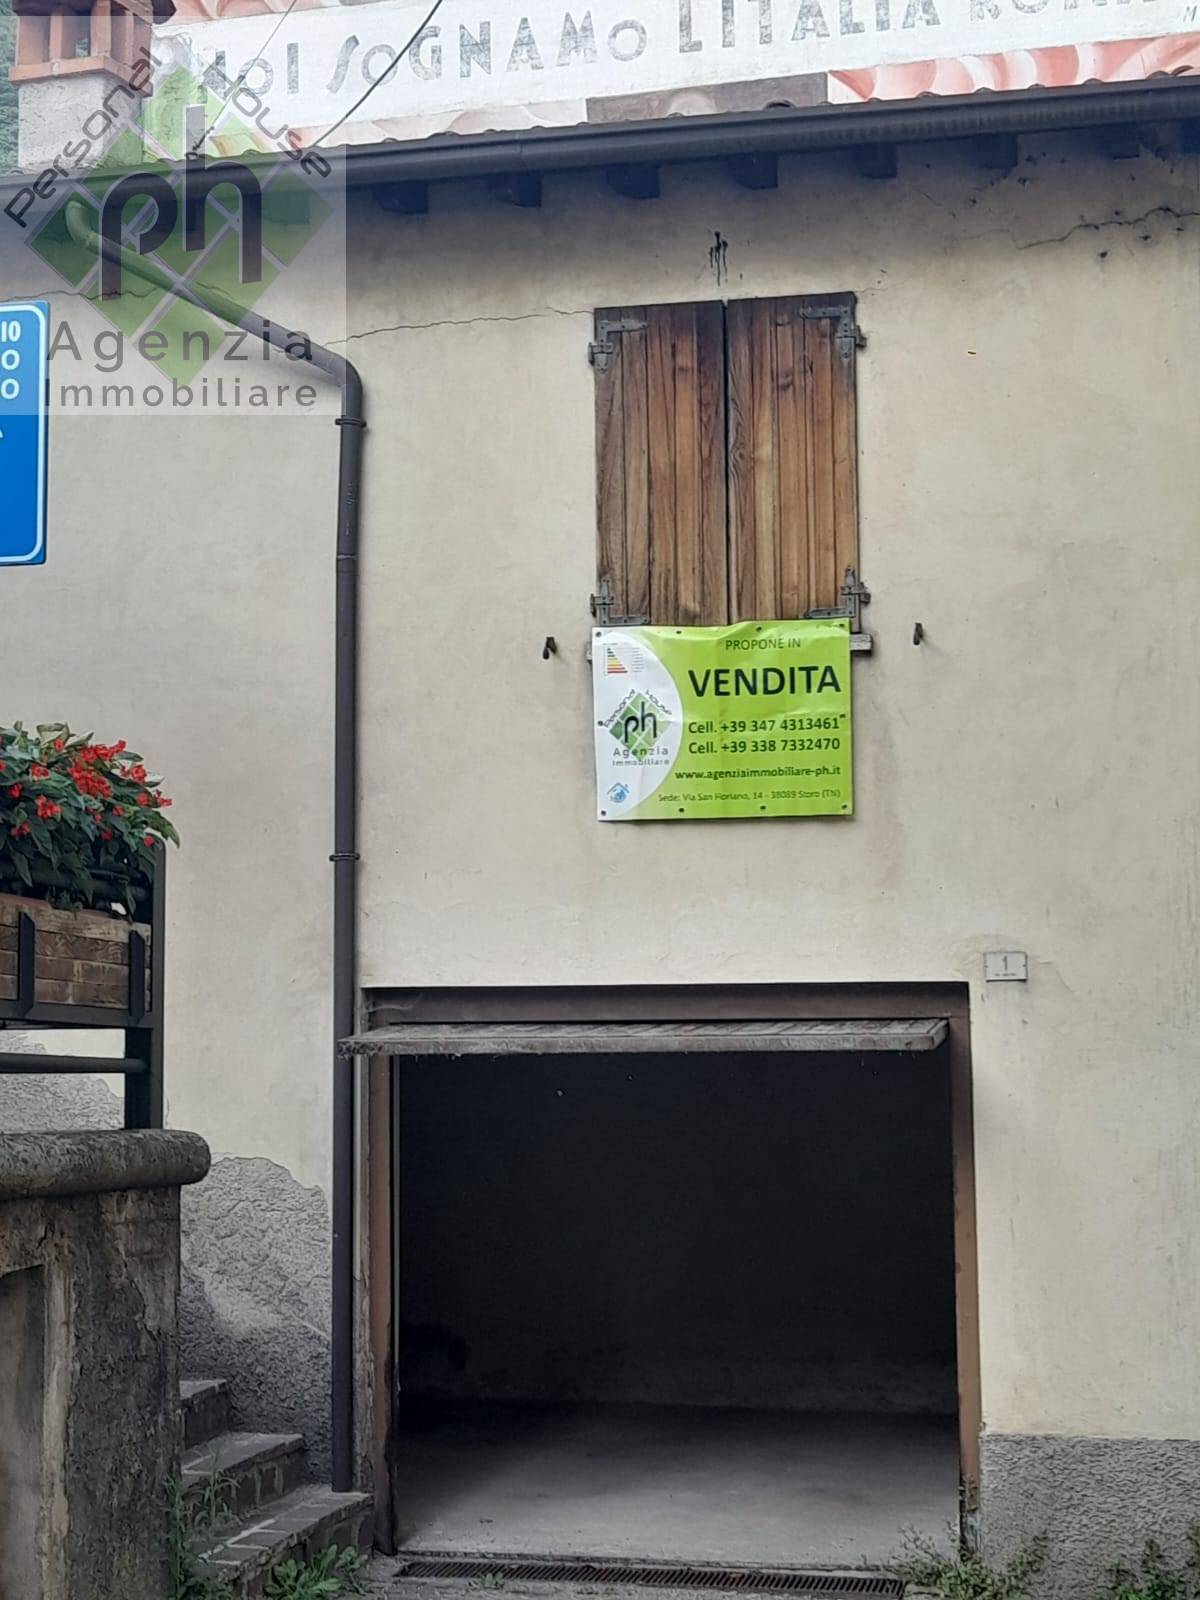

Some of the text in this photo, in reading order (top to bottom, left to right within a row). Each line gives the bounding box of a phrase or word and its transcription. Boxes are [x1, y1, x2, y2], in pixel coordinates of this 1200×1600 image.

[725, 637, 801, 651] PROPONE IN
[688, 665, 841, 697] VENDITA
[624, 701, 658, 743] ph
[688, 717, 840, 734] Cell. +39 347 4313461
[613, 746, 669, 759] Agenzia
[688, 737, 841, 754] Cell. +39 338 7332470
[675, 766, 841, 780] www.agenziaimmobiliare-ph.it
